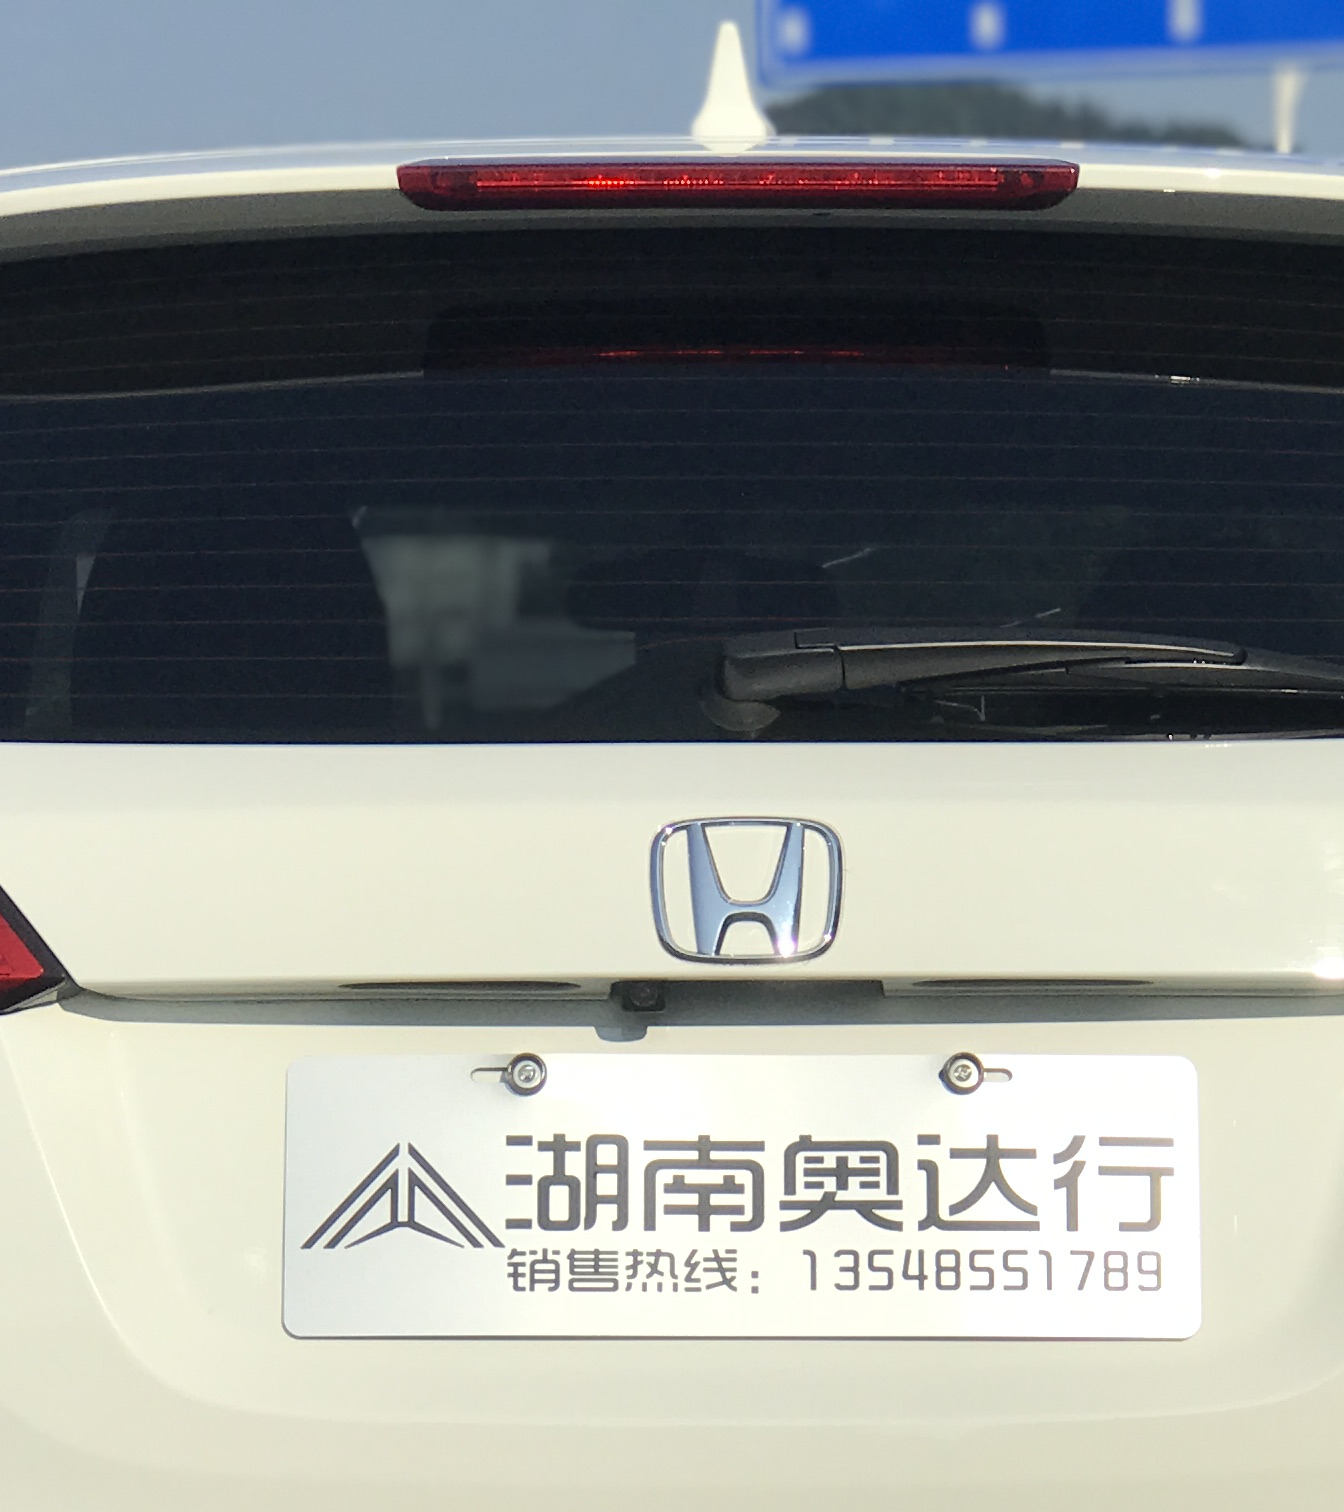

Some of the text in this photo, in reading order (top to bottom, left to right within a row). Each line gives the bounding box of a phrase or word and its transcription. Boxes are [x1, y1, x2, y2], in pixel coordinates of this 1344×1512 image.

[505, 1134, 1175, 1232] 湖南奥达行
